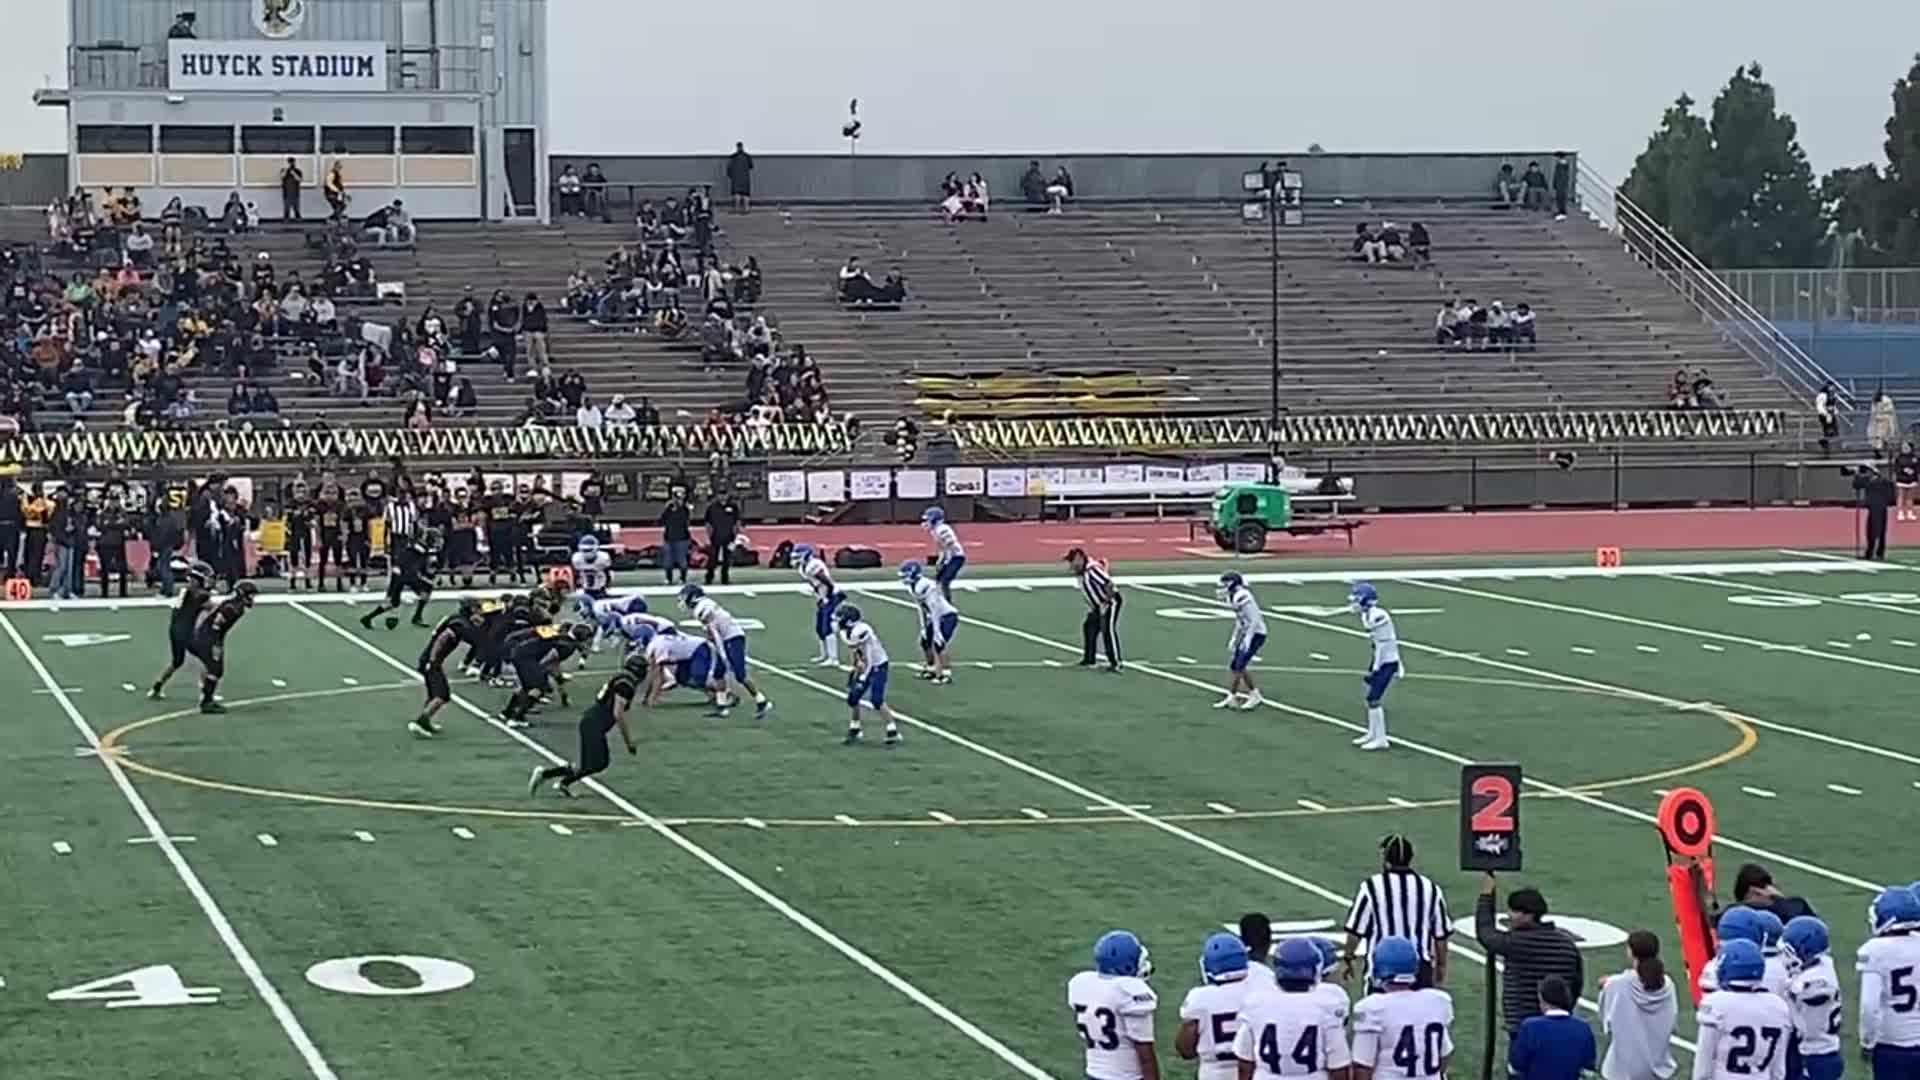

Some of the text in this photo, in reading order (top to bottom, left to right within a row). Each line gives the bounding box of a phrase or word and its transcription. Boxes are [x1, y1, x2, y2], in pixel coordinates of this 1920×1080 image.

[181, 53, 375, 77] HUYCK STADIUM
[10, 582, 28, 599] 40
[1471, 775, 1515, 832] 2
[1073, 1003, 1120, 1051] 53
[1259, 1023, 1318, 1075] 44
[1392, 1022, 1444, 1078] 40
[1726, 1025, 1783, 1075] 27
